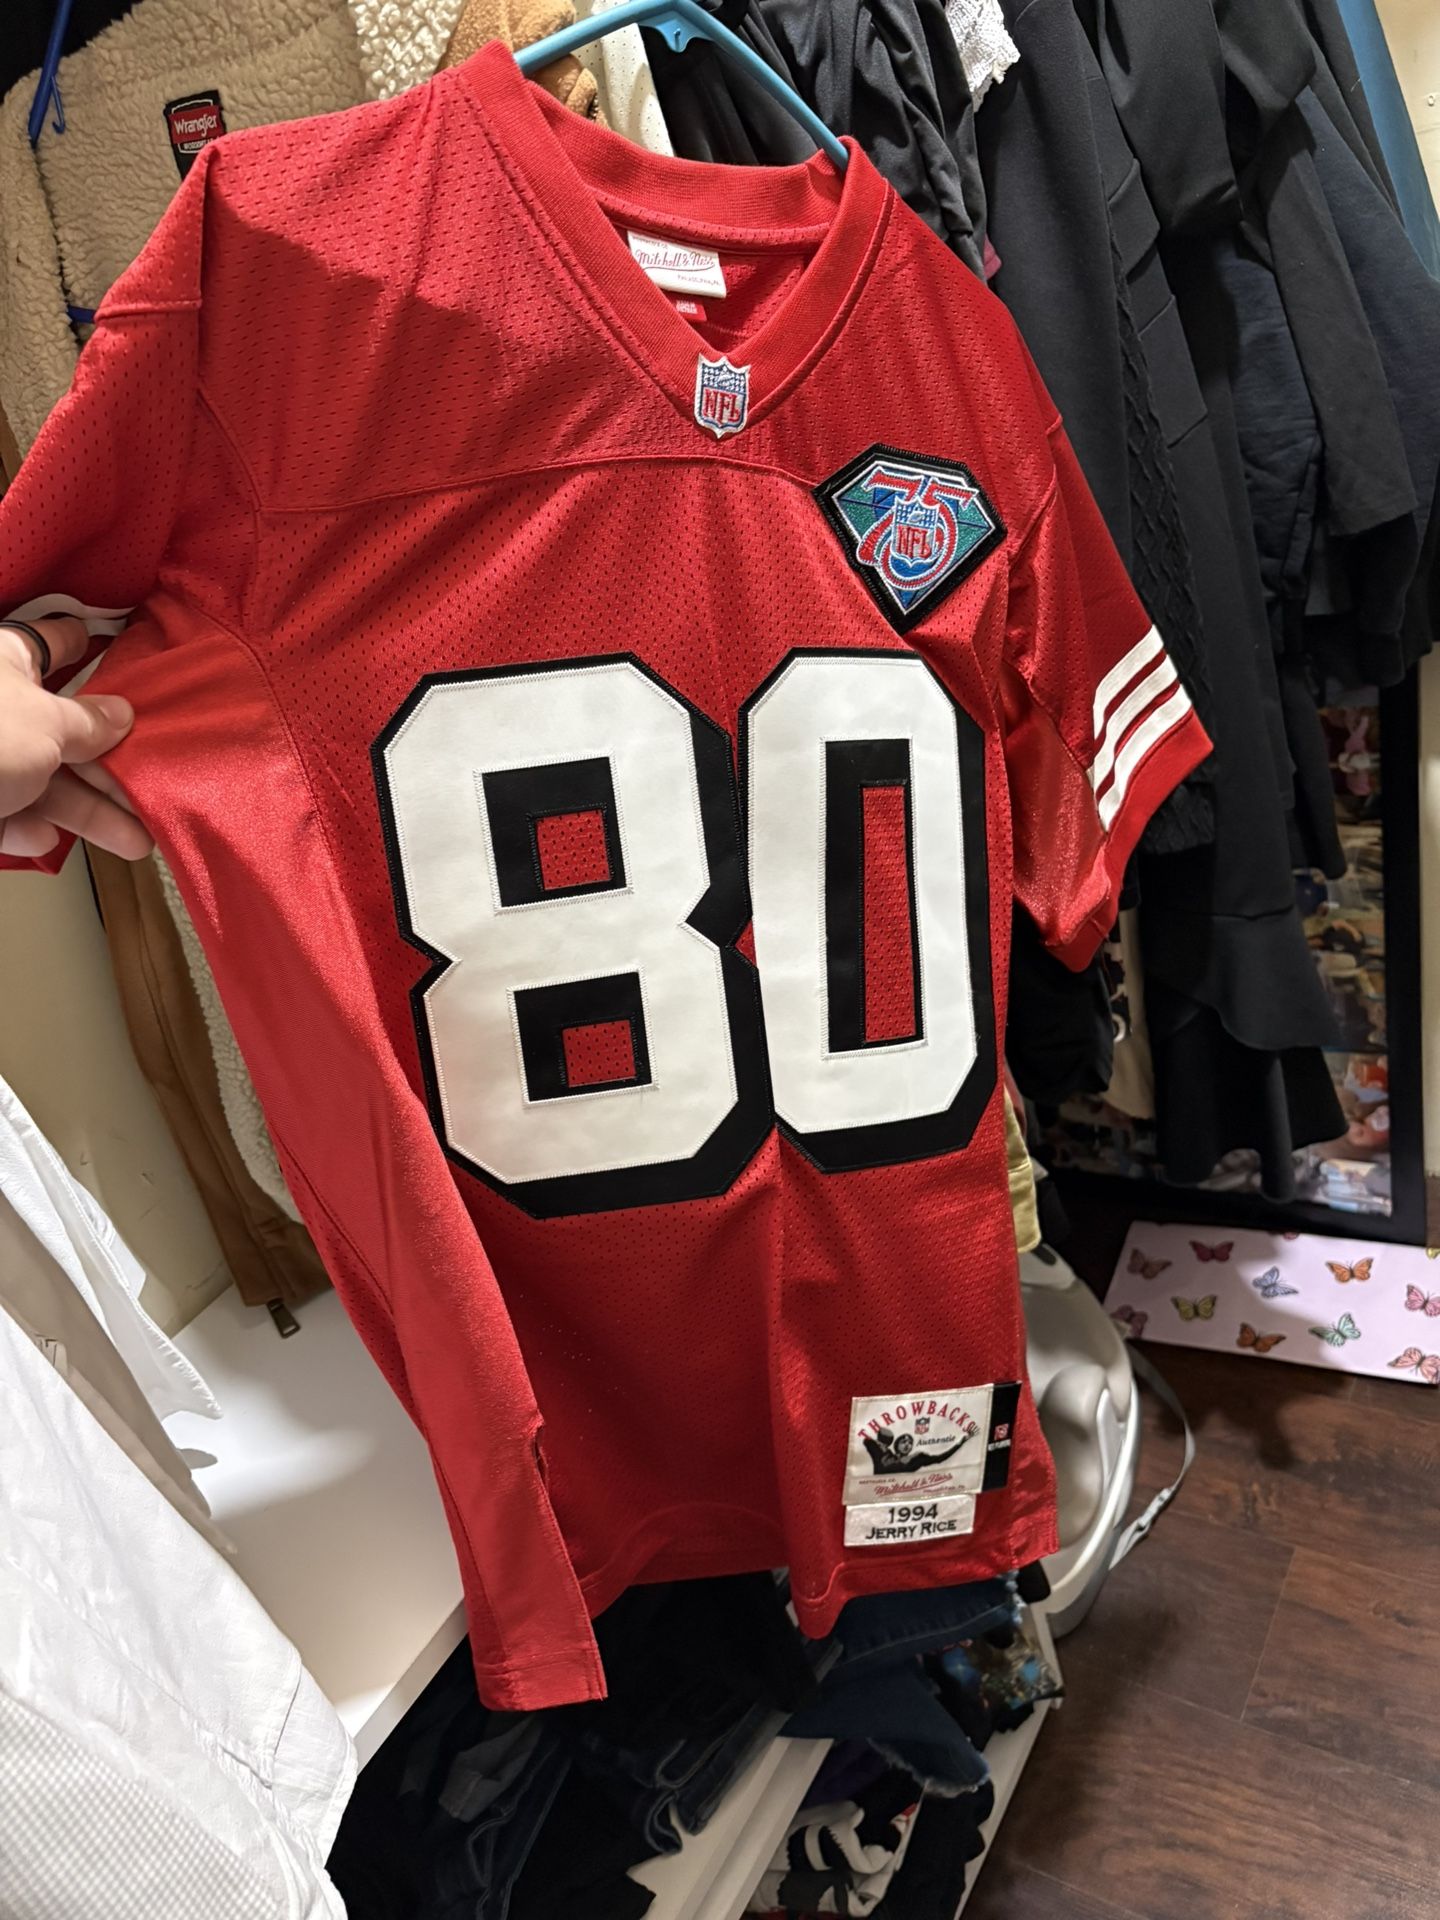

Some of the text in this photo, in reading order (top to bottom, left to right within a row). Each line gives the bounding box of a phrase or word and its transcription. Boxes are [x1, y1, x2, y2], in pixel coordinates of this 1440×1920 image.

[174, 113, 217, 137] Wrangler
[635, 249, 681, 267] Mitchell
[702, 388, 741, 425] NFL
[857, 466, 979, 590] 75
[895, 525, 932, 561] NFL
[370, 648, 998, 1219] 80
[858, 1400, 977, 1441] THROWBACKS
[915, 1434, 956, 1448] Authentic
[873, 1479, 920, 1496] Mitchell
[888, 1503, 938, 1524] 1994
[865, 1519, 957, 1540] JERRY RICE
